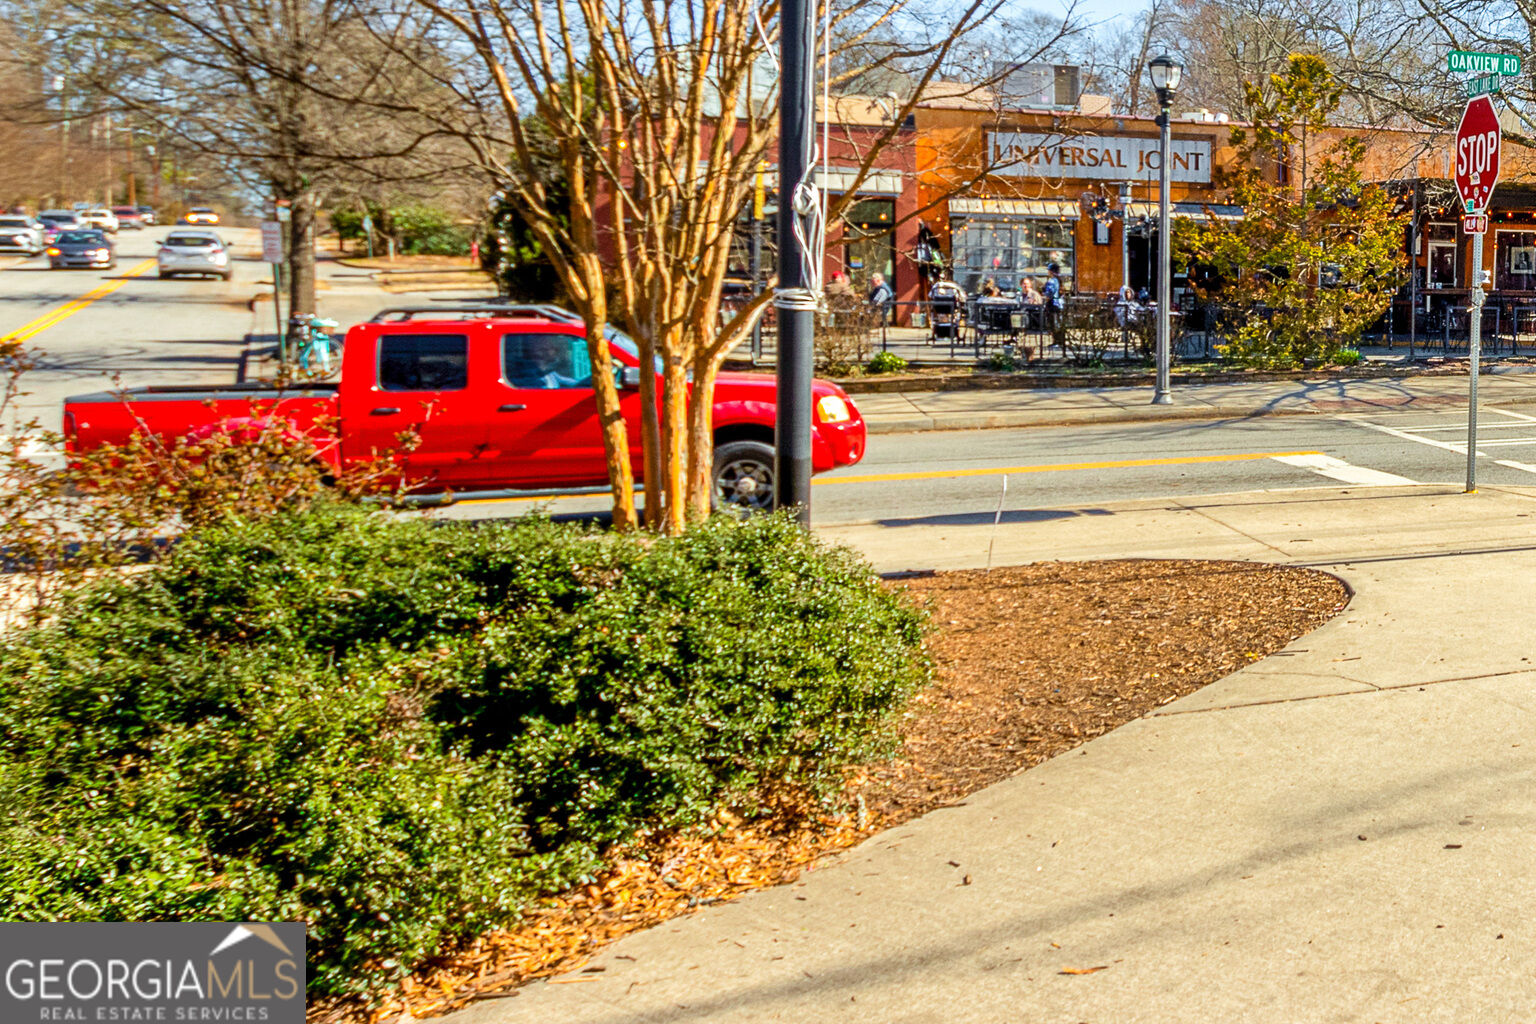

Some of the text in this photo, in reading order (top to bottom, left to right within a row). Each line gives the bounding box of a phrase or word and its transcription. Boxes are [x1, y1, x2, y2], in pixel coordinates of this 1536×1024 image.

[1451, 54, 1517, 72] OAKVIEW RD
[1469, 79, 1479, 96] EAST
[1480, 77, 1490, 92] LAKE
[994, 144, 1204, 173] UNIVERSAL JONT
[1458, 131, 1497, 176] STOP
